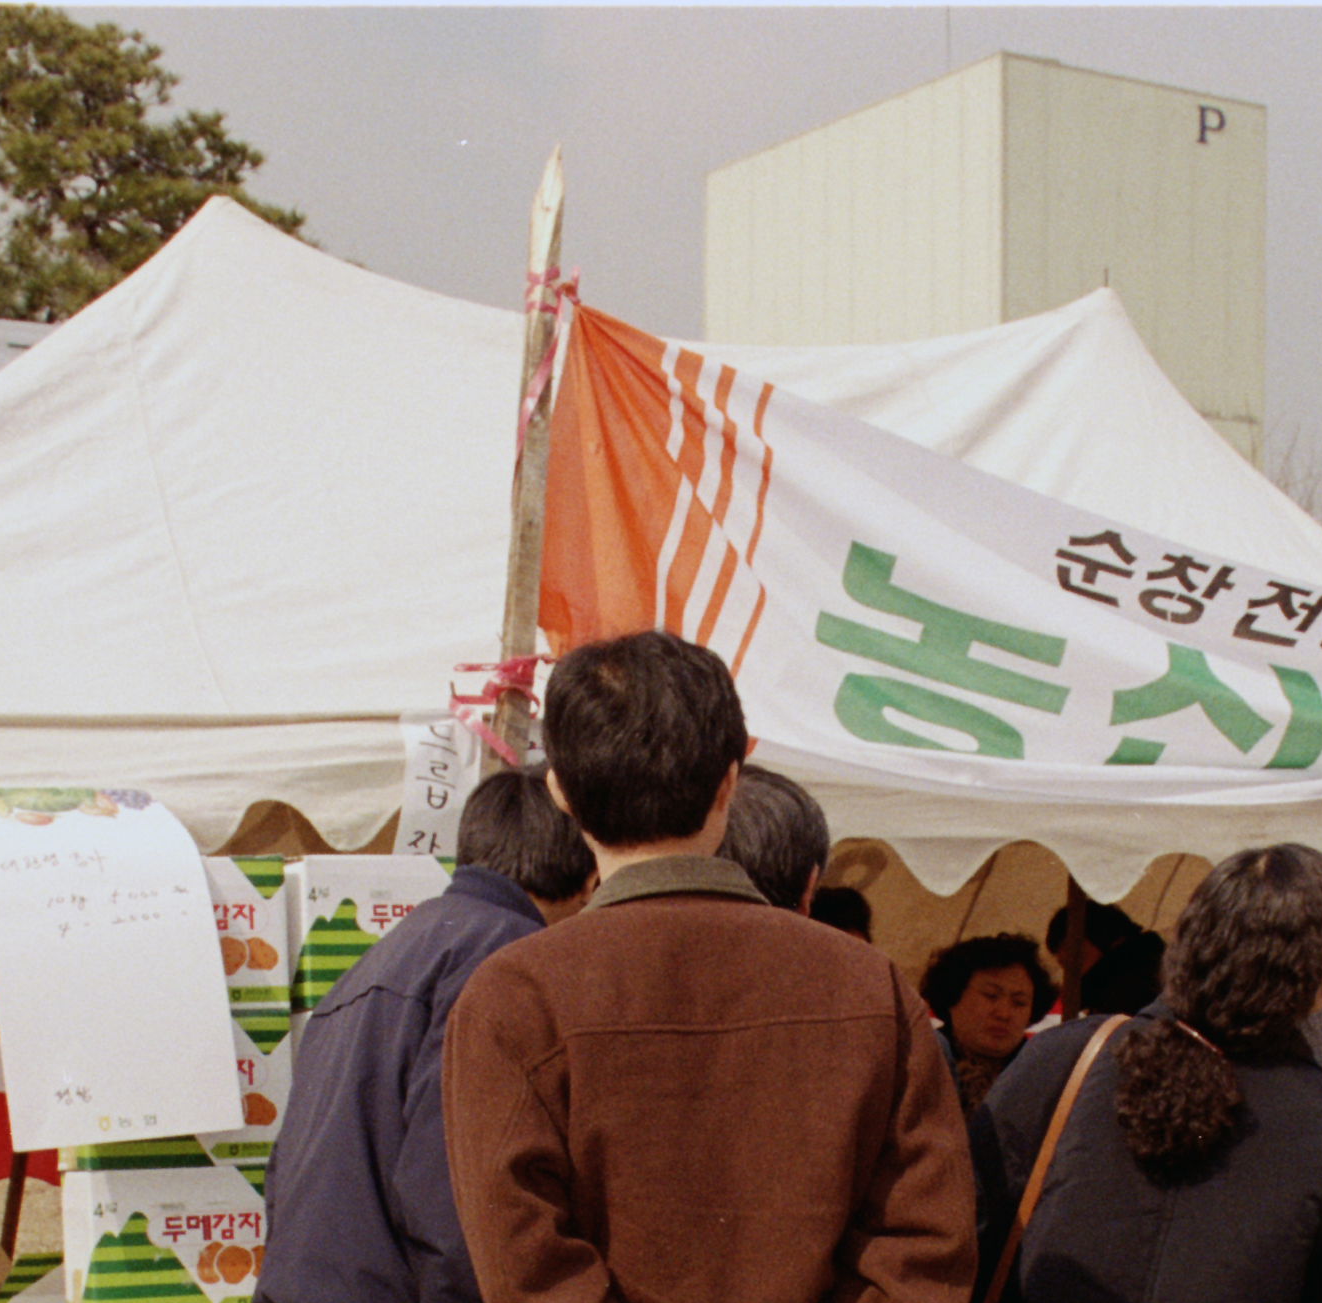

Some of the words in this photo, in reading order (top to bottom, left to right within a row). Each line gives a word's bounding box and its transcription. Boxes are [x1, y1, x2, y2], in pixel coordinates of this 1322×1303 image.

[1196, 105, 1226, 143] P
[1055, 529, 1238, 628] 순창
[162, 1210, 262, 1244] 두메감자
